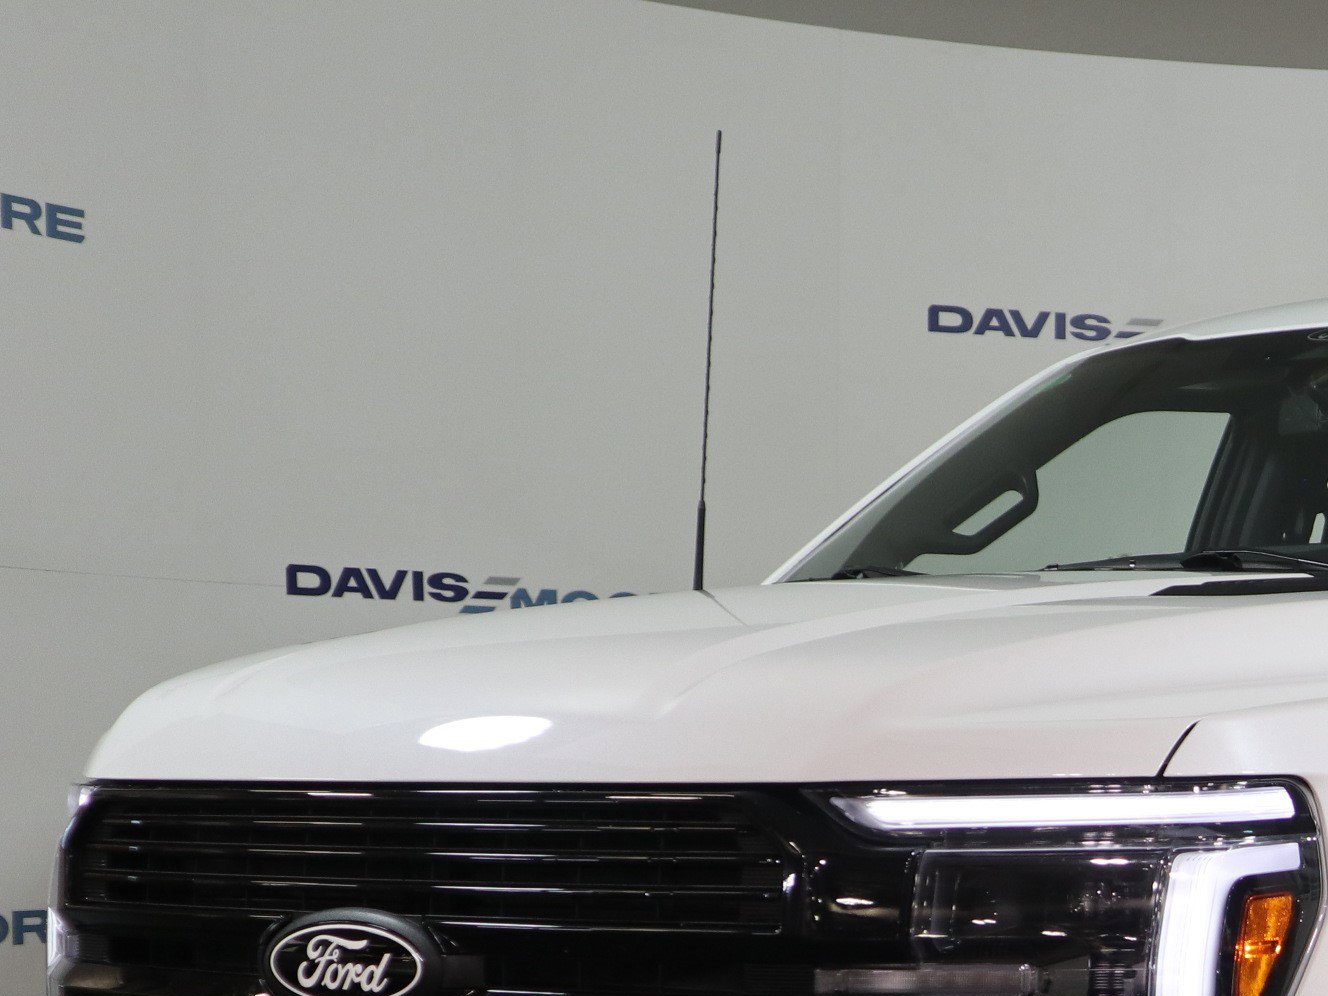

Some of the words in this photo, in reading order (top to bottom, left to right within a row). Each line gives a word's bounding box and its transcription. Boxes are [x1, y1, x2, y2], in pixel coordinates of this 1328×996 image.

[0, 193, 85, 243] RE
[927, 304, 1111, 341] DAVIS
[286, 563, 468, 602] DAVIS
[0, 910, 47, 945] R
[297, 934, 392, 993] Ford
